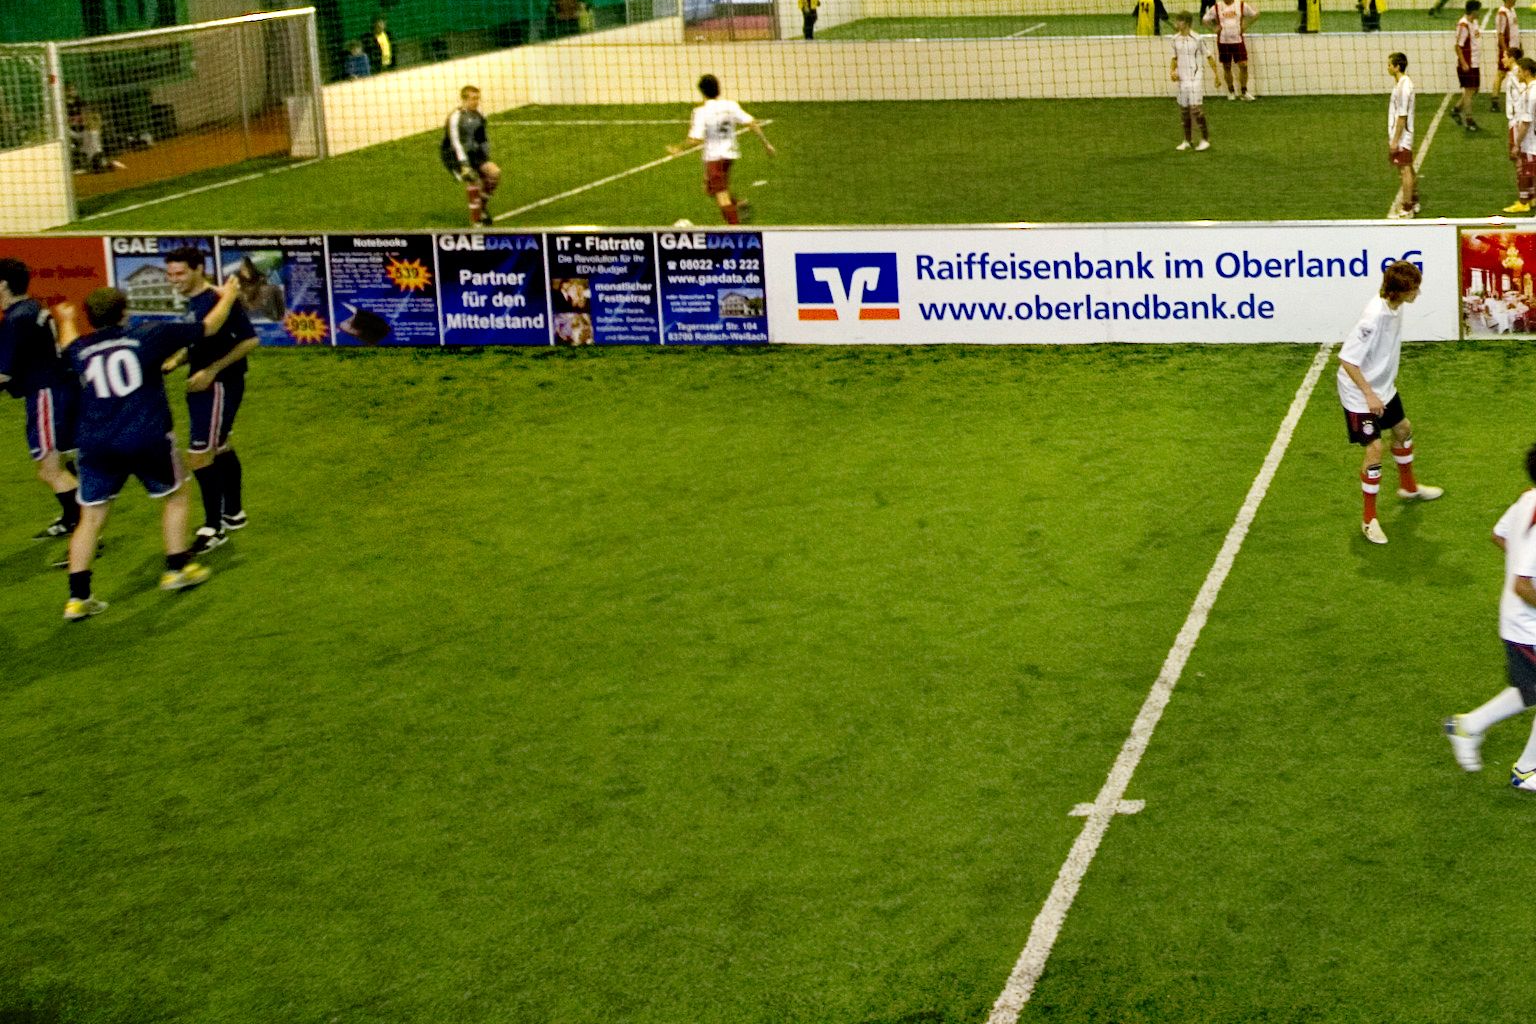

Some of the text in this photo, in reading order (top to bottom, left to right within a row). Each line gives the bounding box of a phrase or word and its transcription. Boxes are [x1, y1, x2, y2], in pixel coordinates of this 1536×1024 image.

[279, 237, 308, 246] Gamer
[309, 237, 322, 246] PC
[353, 237, 408, 247] Notebooks
[556, 236, 571, 251] IT
[585, 236, 645, 251] Flatrate
[558, 254, 572, 263] Die
[574, 254, 618, 263] Revolution
[680, 259, 713, 270] 08022
[739, 259, 760, 270] 222
[916, 251, 1154, 280] Raiffeisenbank
[1165, 252, 1203, 278] im
[1215, 249, 1368, 278] Oberland
[576, 265, 628, 275] EDV-Budget
[459, 269, 526, 285] Partner
[668, 273, 760, 286] www.gaedata.de
[594, 281, 653, 291] monatlicher
[461, 291, 526, 307] für den
[598, 293, 651, 305] Festbetrag
[918, 293, 1275, 321] www.oberlandbank.de
[446, 313, 545, 329] Mittelstand
[85, 349, 143, 398] 10
